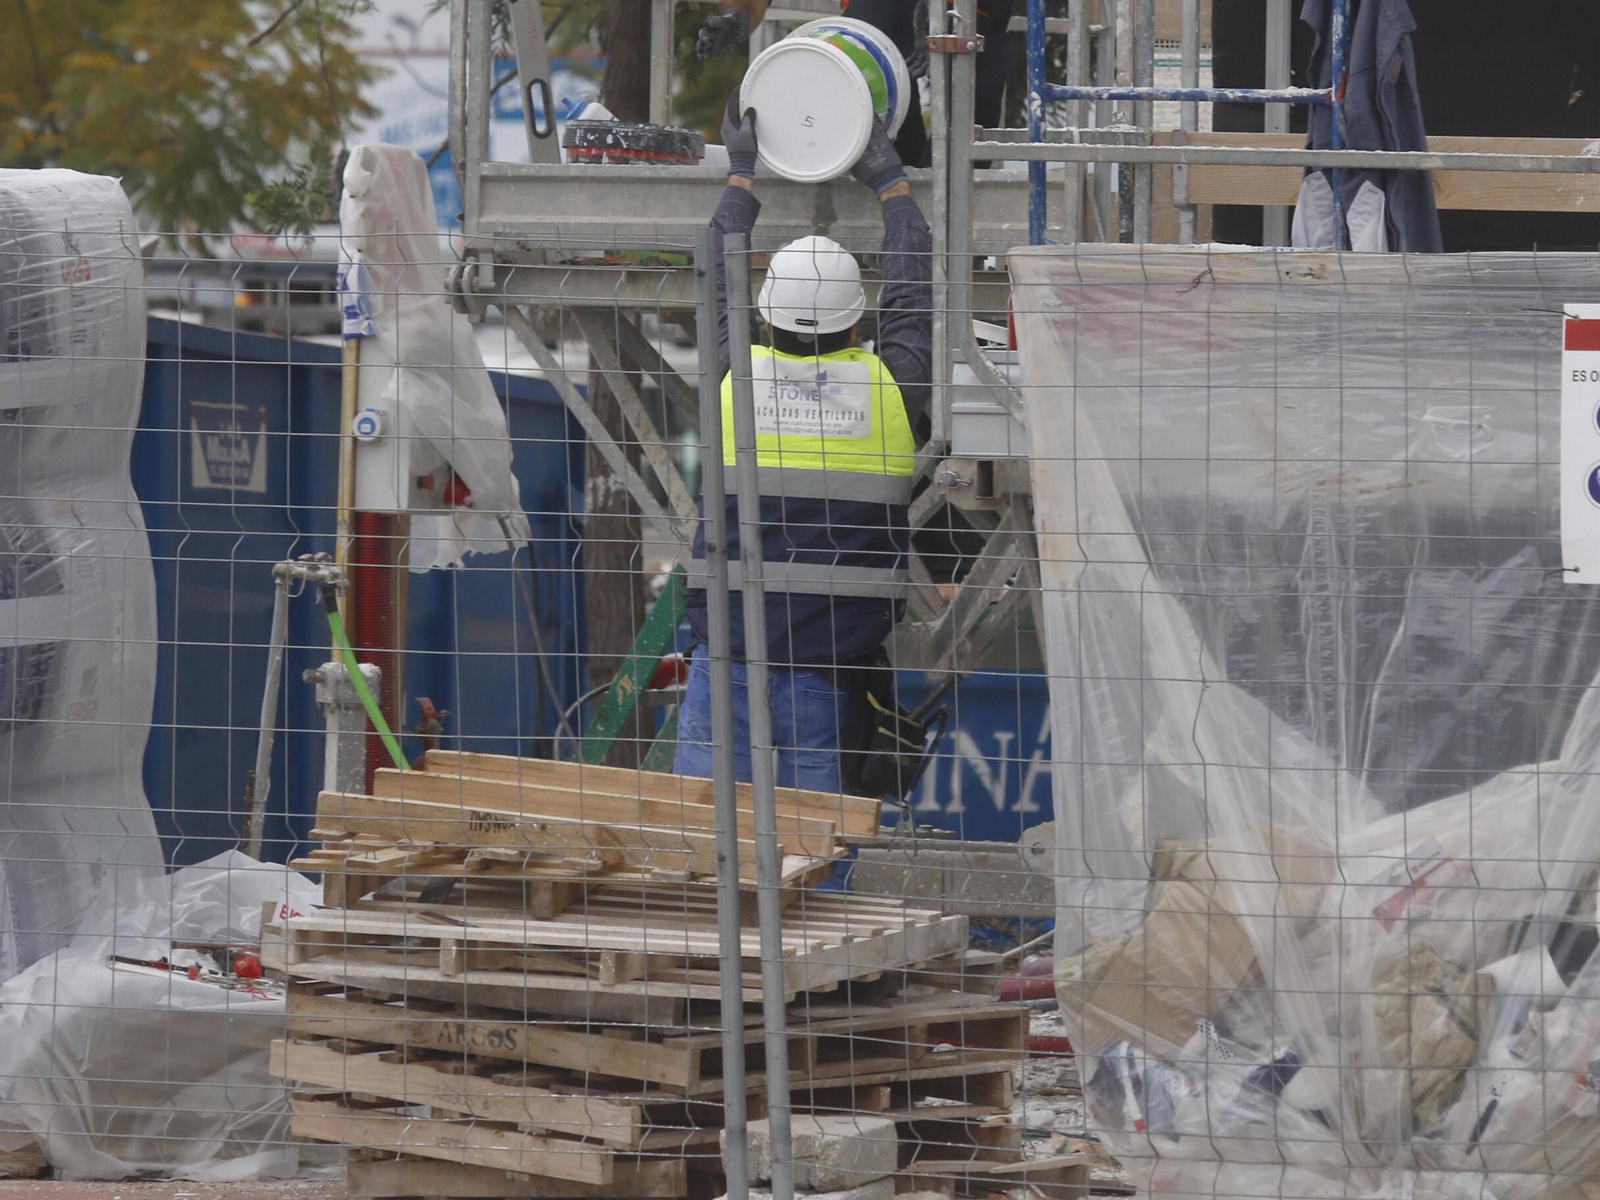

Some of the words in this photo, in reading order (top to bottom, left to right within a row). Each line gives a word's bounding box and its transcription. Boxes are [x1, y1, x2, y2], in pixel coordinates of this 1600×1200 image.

[800, 115, 815, 128] 5
[1572, 370, 1587, 382] ES
[1590, 370, 1600, 382] O
[768, 386, 820, 401] STONE
[754, 406, 799, 418] ACHDAS
